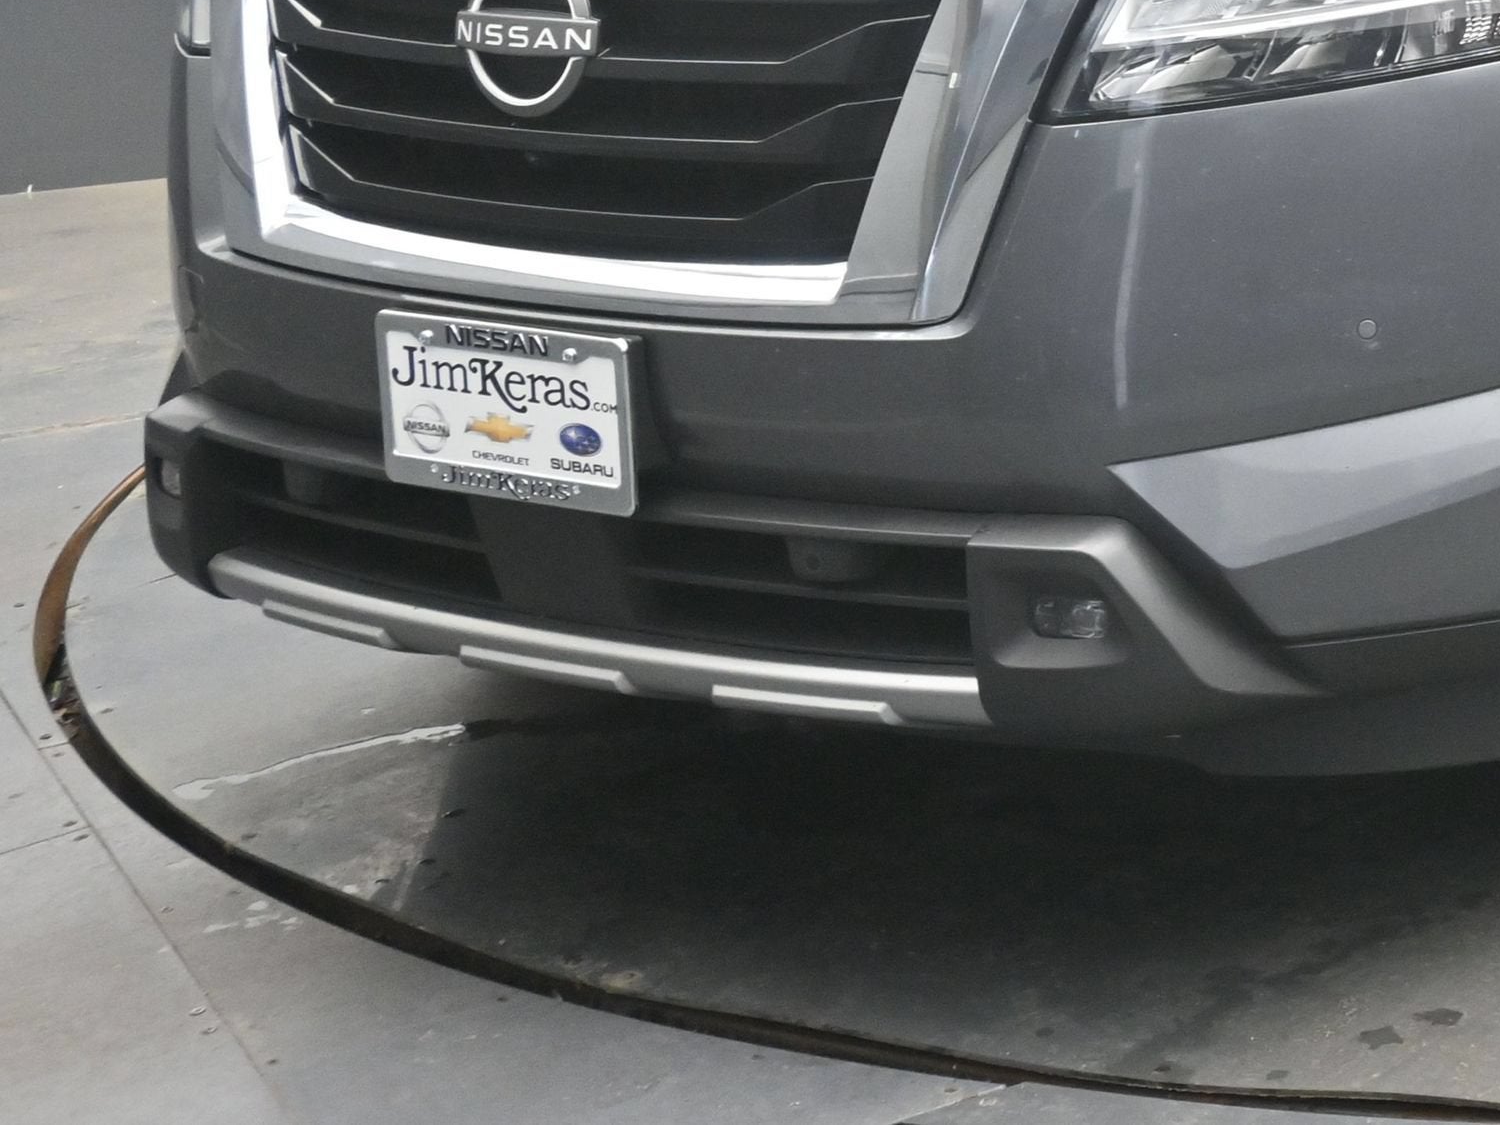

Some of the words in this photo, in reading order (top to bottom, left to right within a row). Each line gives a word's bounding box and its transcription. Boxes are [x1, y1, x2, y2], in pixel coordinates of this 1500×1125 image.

[457, 19, 592, 50] NISSAN
[446, 325, 548, 356] NISSAN
[405, 419, 447, 434] NISSAN
[472, 450, 529, 466] CHEVROLET
[550, 458, 614, 477] SUBARU
